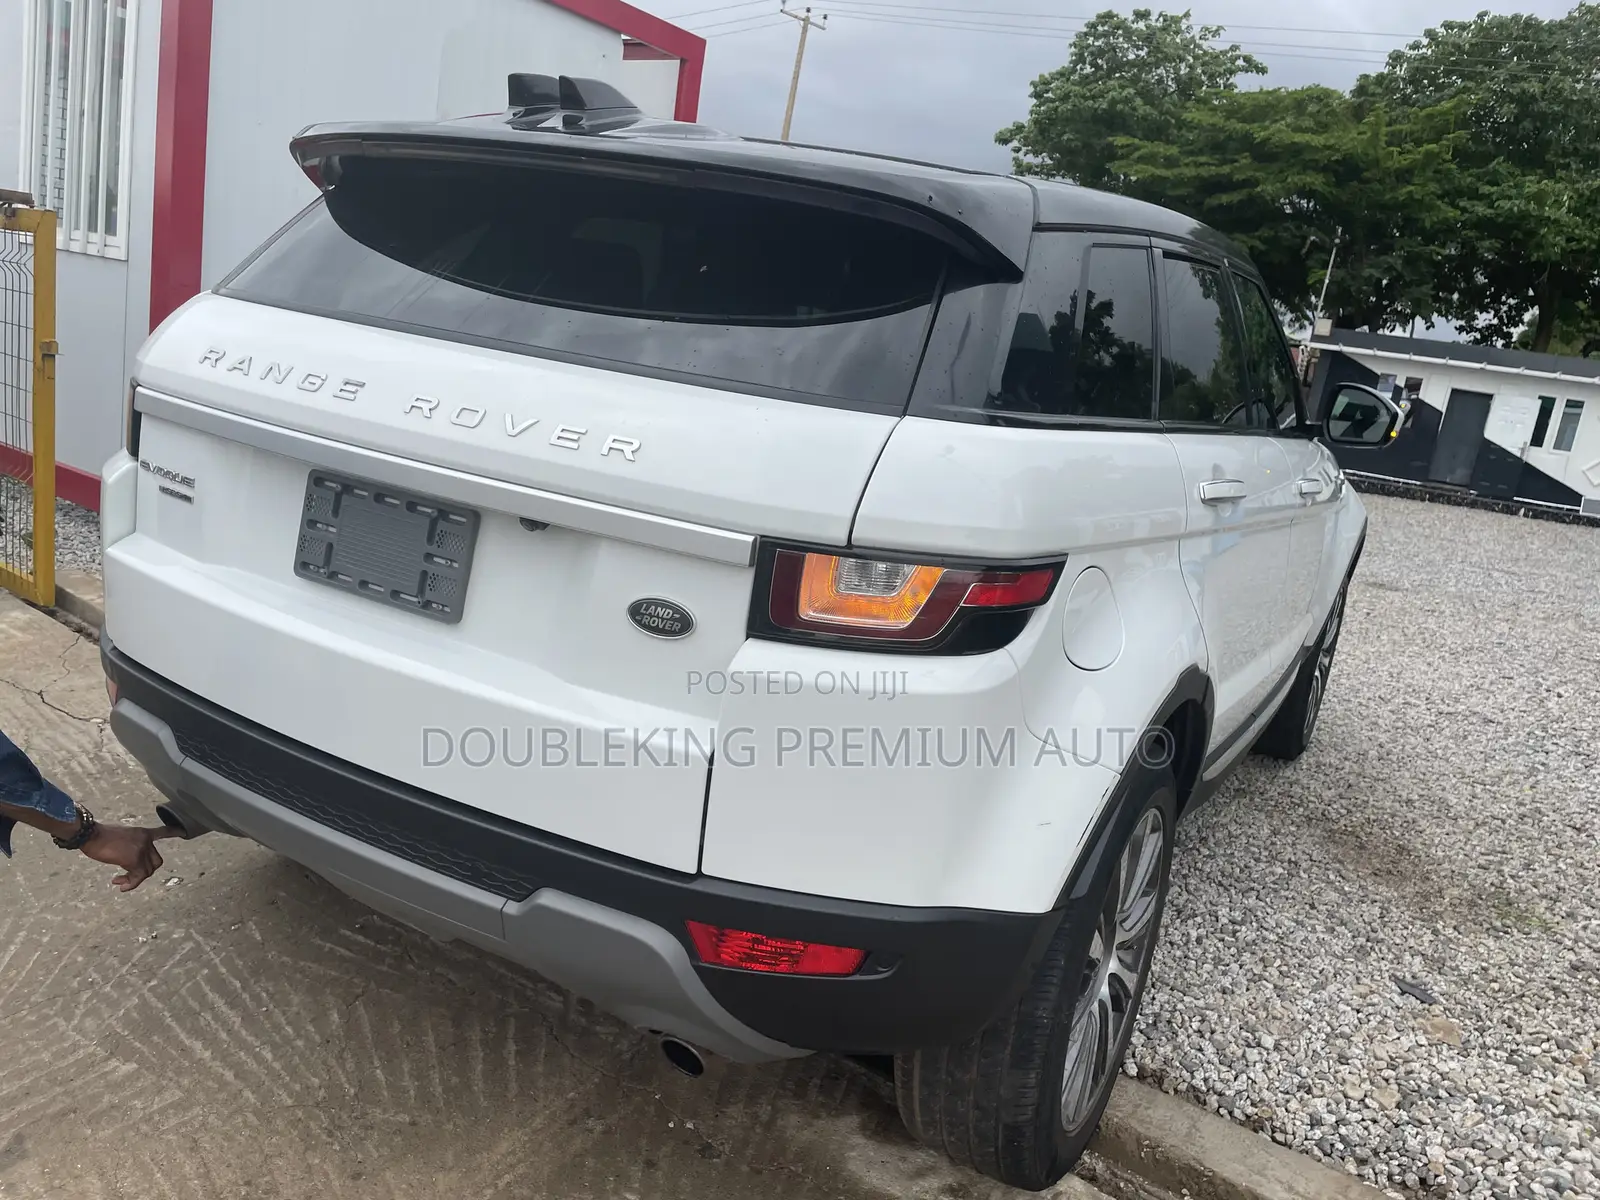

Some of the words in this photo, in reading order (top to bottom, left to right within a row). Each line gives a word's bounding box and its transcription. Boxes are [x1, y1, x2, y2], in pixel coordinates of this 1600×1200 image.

[199, 346, 366, 402] RANGE
[404, 393, 642, 462] ROVER
[140, 459, 196, 489] EVOQUE
